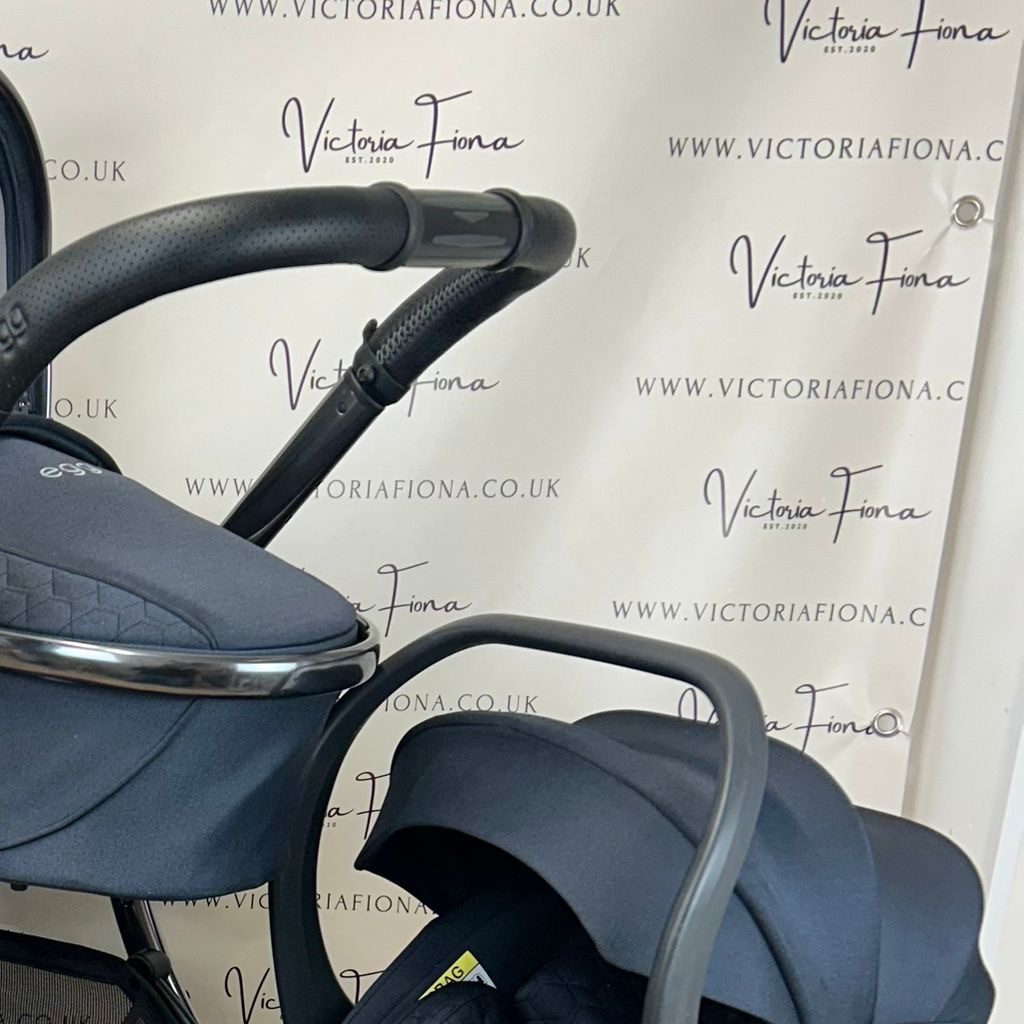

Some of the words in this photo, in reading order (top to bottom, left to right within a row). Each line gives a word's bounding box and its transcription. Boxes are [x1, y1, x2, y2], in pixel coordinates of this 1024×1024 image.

[210, 0, 620, 20] WWW.VICTORIAFIONA.CO.UK
[823, 45, 876, 54] EST.2020
[282, 97, 414, 173] Victoria
[415, 90, 524, 179] Fiona
[344, 156, 395, 164] EST.2020
[730, 234, 864, 309] Victoria
[865, 229, 971, 316] Fiona
[792, 291, 843, 300] EST.2020
[703, 467, 828, 538] Victoria
[828, 464, 933, 545] Fiona
[377, 560, 473, 637] Fiona
